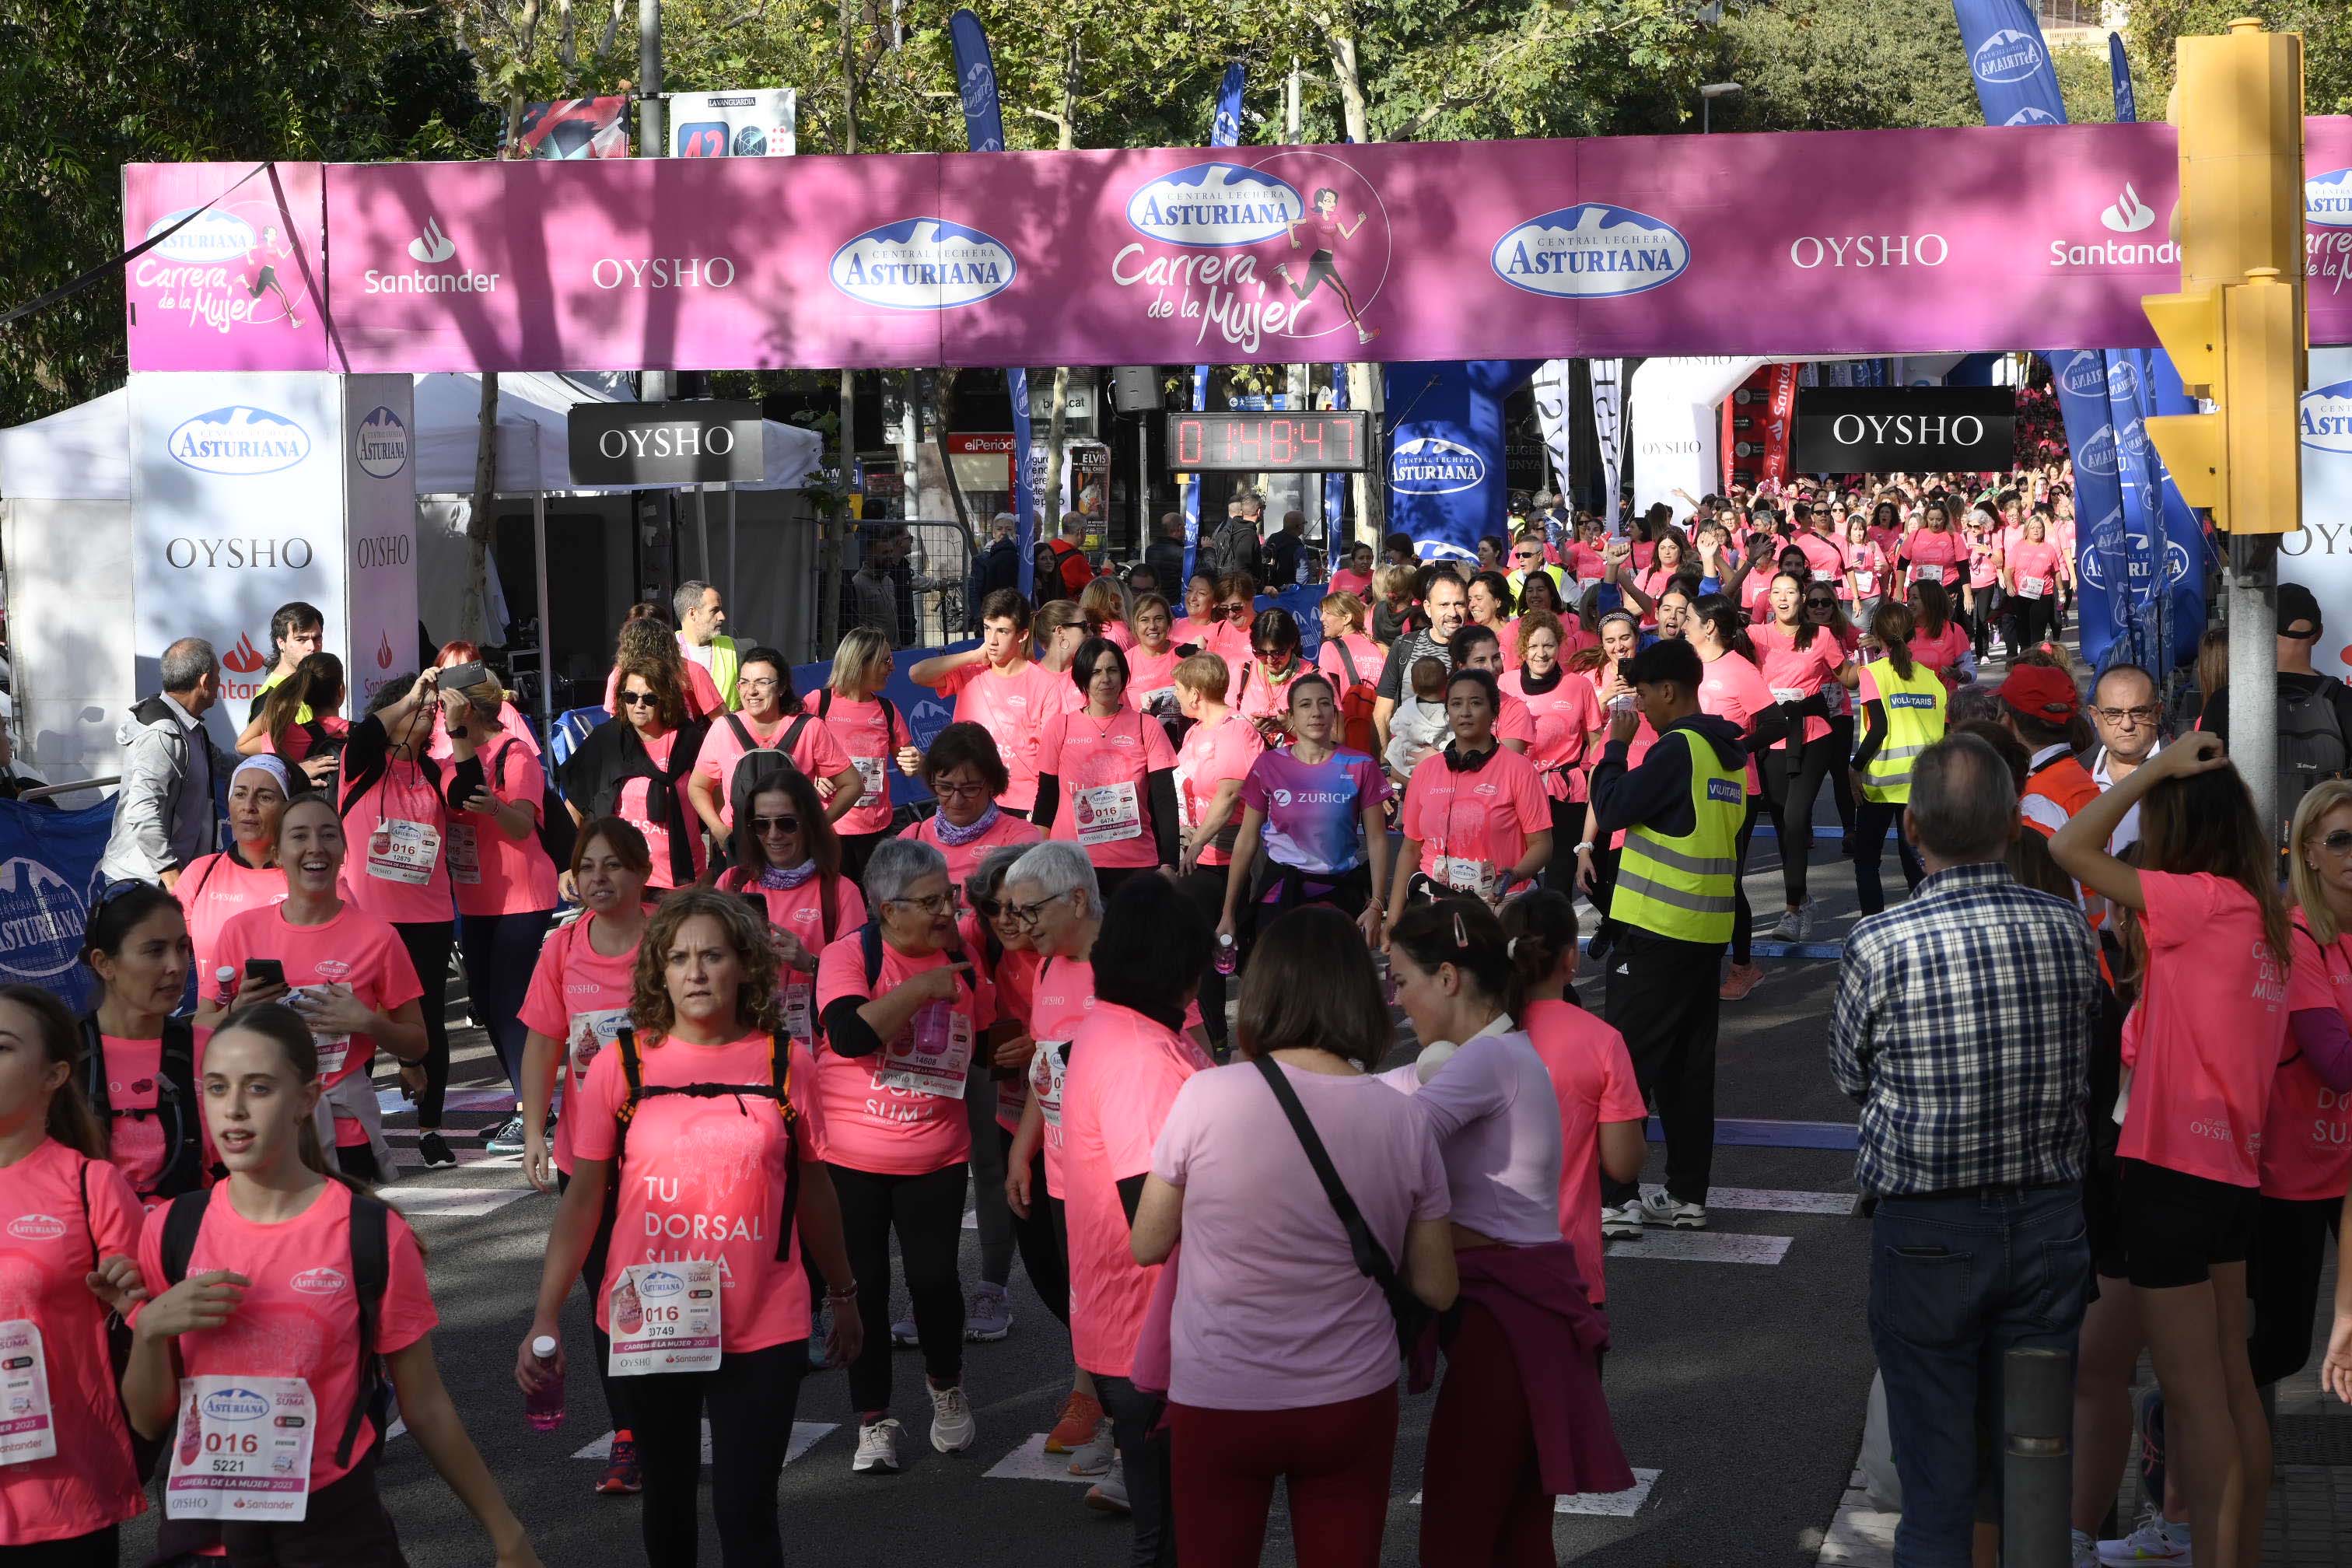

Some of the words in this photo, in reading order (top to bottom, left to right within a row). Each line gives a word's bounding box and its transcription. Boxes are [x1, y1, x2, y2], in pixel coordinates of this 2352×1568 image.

[716, 98, 755, 107] VANGUARDIA
[1229, 191, 1285, 199] LECHERA
[1140, 194, 1290, 226] ASTURIANA
[1538, 236, 1598, 247] CENTRAL
[1605, 235, 1668, 245] LECHERA
[873, 249, 929, 258] CENTRAL
[1507, 240, 1675, 274] ASTURIANA
[1791, 233, 1948, 268] OYSHO
[2050, 240, 2181, 266] Santande
[845, 252, 1002, 285] ASTURIANA
[1112, 243, 1258, 285] Carrera
[2322, 255, 2336, 276] la
[136, 258, 228, 288] Carrera
[365, 269, 500, 293] Santander
[592, 257, 735, 289] OYSHO
[159, 289, 174, 310] de
[179, 288, 191, 310] la
[190, 288, 261, 333] Mujer
[1148, 289, 1174, 318] de
[1181, 286, 1200, 318] la
[1196, 281, 1312, 353] Mujer
[2300, 408, 2352, 436] ASTU
[1833, 415, 1983, 446] OYSHO
[180, 432, 300, 457] ASTURIANA
[359, 432, 405, 460] ASTURIANA
[599, 425, 734, 459] OYSHO
[965, 439, 1016, 451] elPeriód
[1180, 420, 1354, 463] 01:48:47
[1643, 441, 1701, 455] OYSHO
[1082, 454, 1106, 464] ELVIS
[1391, 460, 1478, 481] ASTURIANA
[166, 537, 313, 569] OYSHO
[358, 534, 409, 569] OYSHO
[1297, 793, 1351, 804] ZURICH
[1430, 786, 1456, 795] OYSHO
[1096, 807, 1117, 817] 016
[393, 843, 415, 855] 016
[210, 891, 243, 902] OYSHO
[567, 984, 600, 994] OYSHO
[884, 1073, 910, 1083] OYSHO
[644, 1176, 678, 1202] TU
[12, 1223, 63, 1234] ASTURIANA
[645, 1211, 763, 1241] DORSAL
[292, 1276, 345, 1288] ASTURIANA
[646, 1306, 679, 1322] 016
[620, 1357, 651, 1368] OYSHO
[675, 1354, 713, 1363] Santander
[206, 1399, 264, 1414] ASTURIANA
[1, 1440, 42, 1454] antander
[205, 1433, 258, 1453] 016
[212, 1459, 245, 1472] 5221
[210, 1479, 225, 1487] DE
[238, 1480, 270, 1489] MUJER
[273, 1481, 293, 1489] 2023
[172, 1498, 208, 1510] OYSHO
[247, 1500, 295, 1510] Santander
